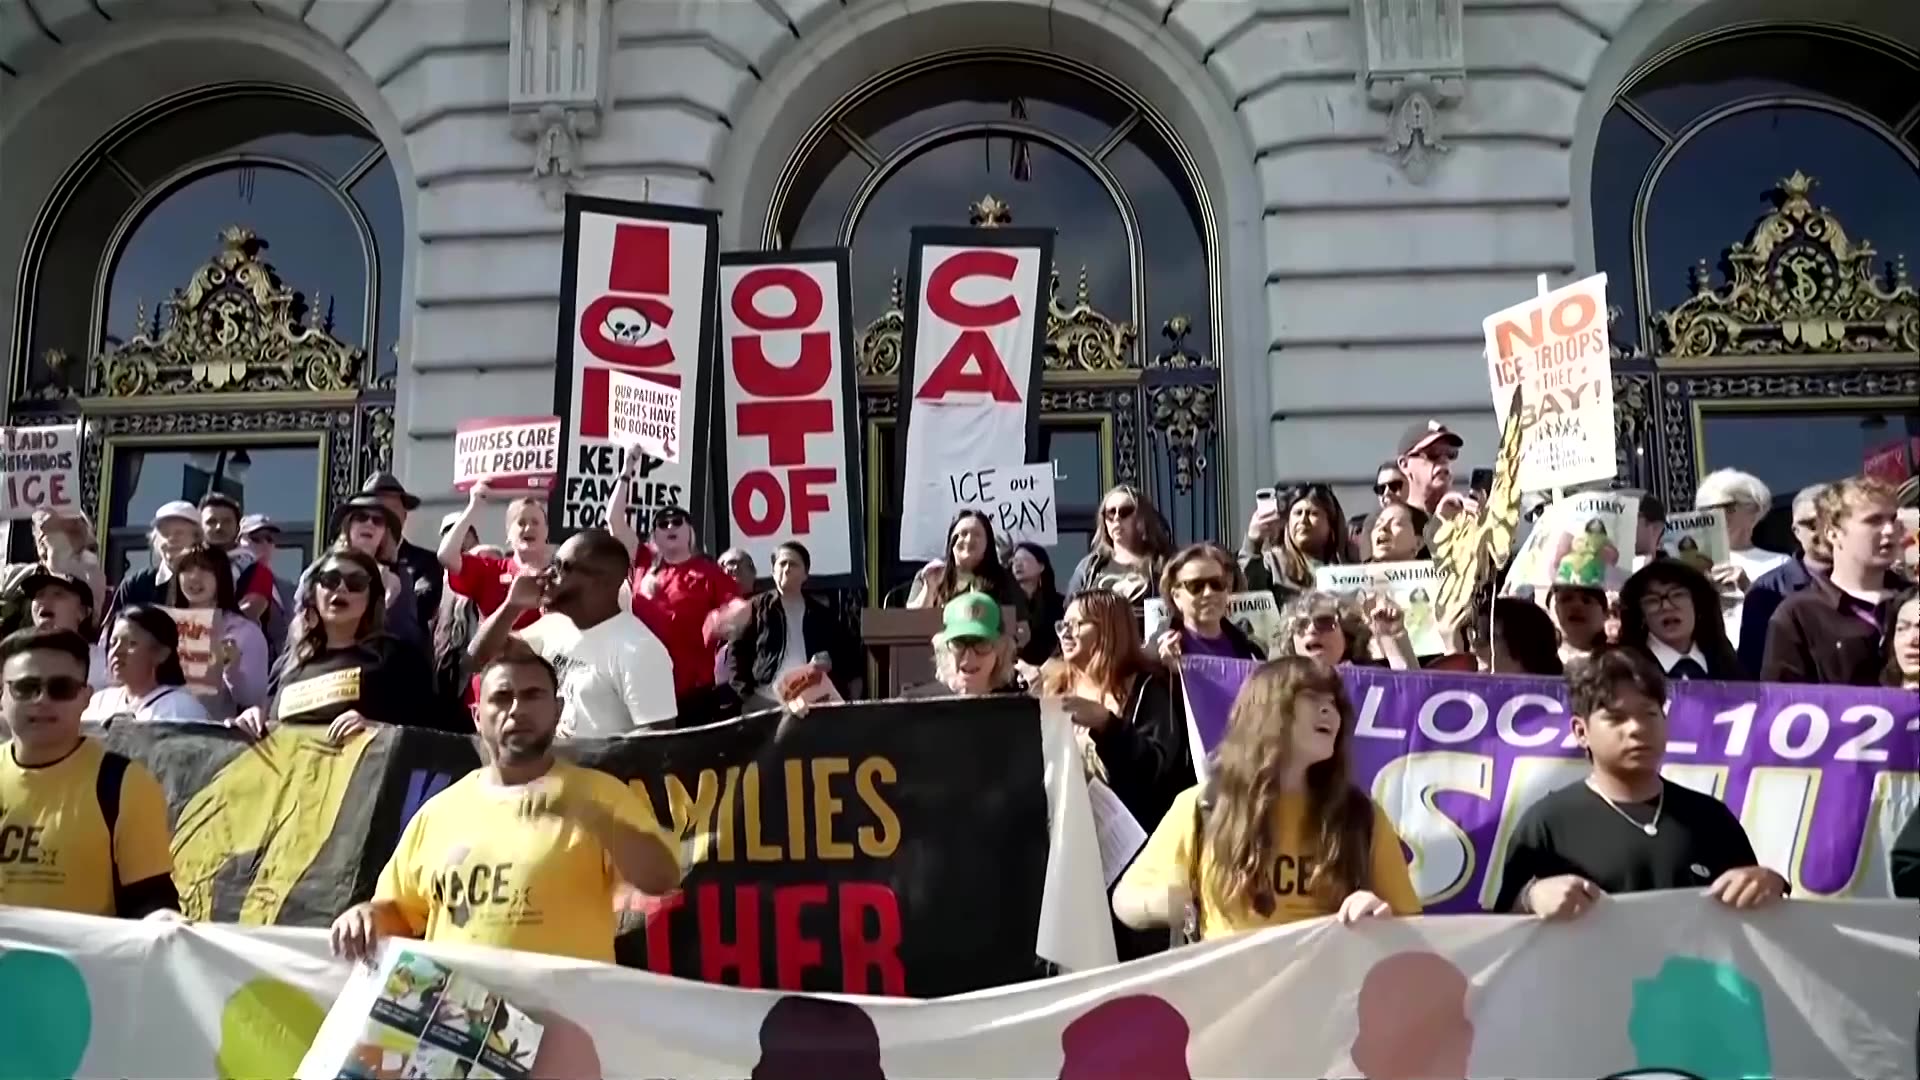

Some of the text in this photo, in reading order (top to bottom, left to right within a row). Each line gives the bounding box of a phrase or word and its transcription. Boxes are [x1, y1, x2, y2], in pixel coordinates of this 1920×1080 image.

[915, 250, 1023, 403] CA
[1495, 293, 1597, 360] NO
[731, 267, 834, 466] OUT
[1495, 328, 1605, 388] ICE TROOPS
[614, 384, 633, 400] OUR
[613, 414, 677, 442] NO BORDERS
[614, 399, 677, 426] RIGHTS HAVE
[459, 426, 556, 455] NURSES CARE
[464, 448, 554, 477] ALL PEOPLE
[579, 445, 664, 478] KEP
[8, 474, 72, 509] ICE
[732, 468, 837, 538] OF
[950, 468, 995, 504] ICE
[998, 497, 1051, 533] BAY
[1713, 702, 1919, 763] 102
[628, 756, 901, 863] MILIES
